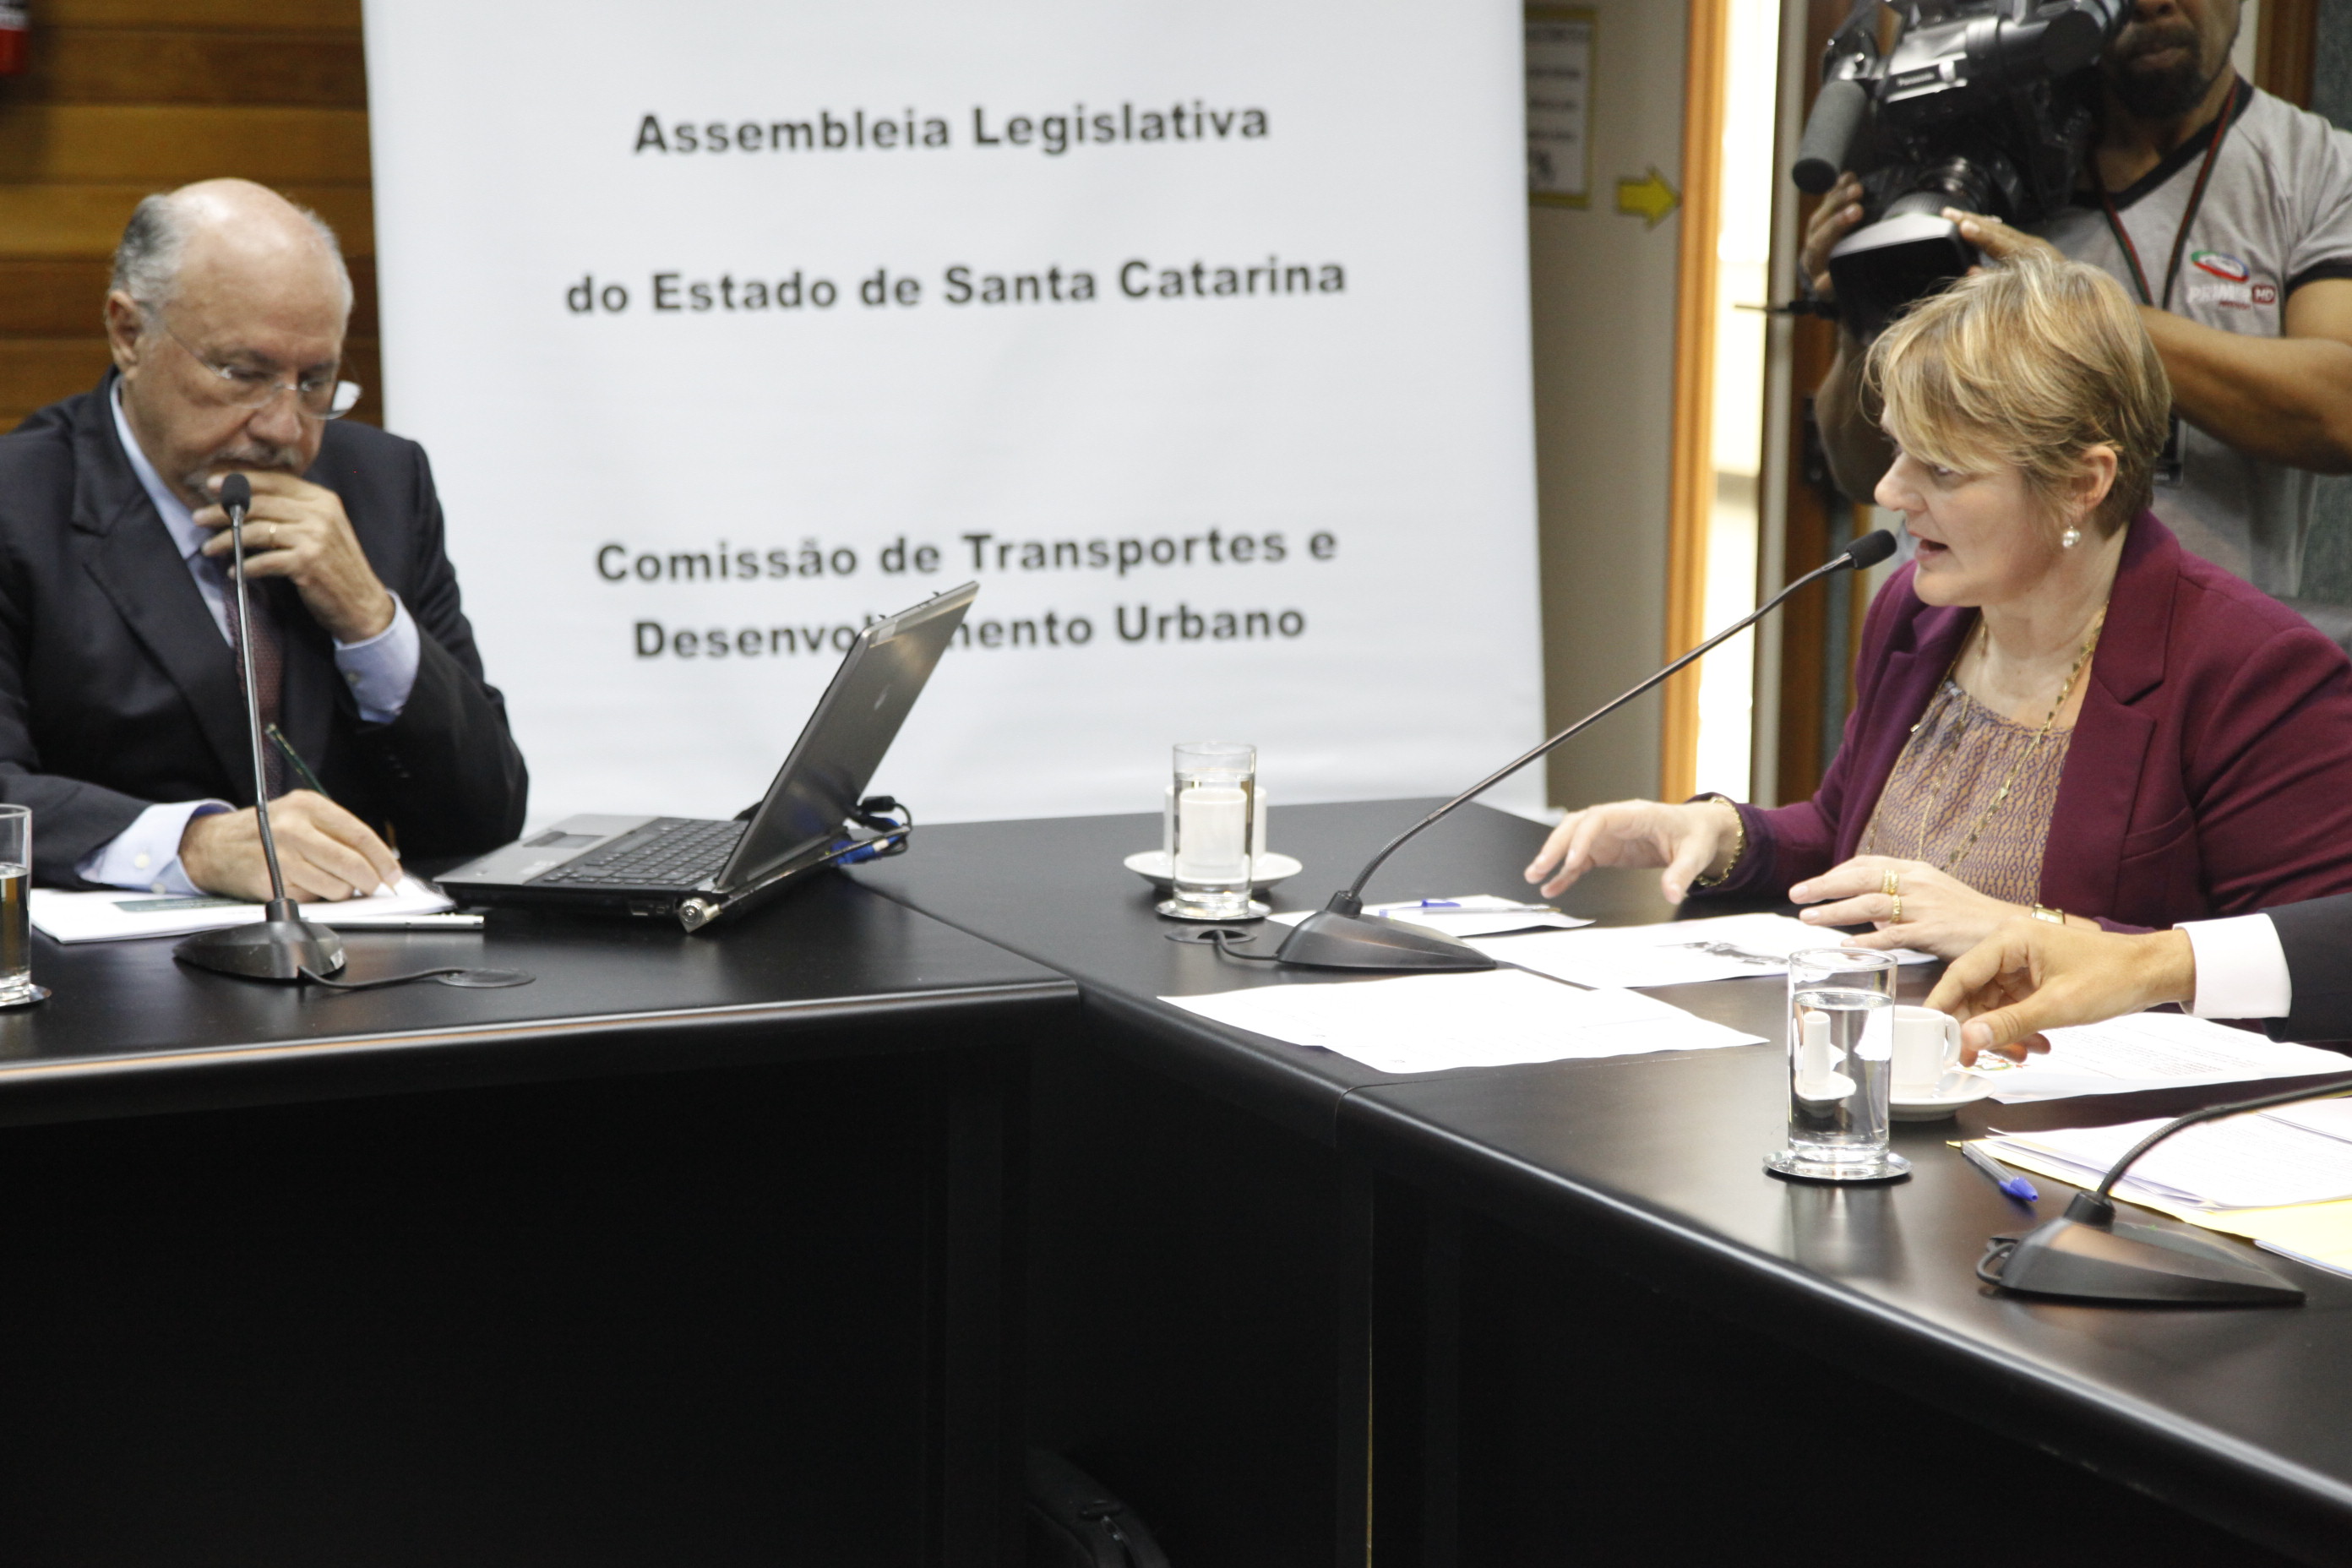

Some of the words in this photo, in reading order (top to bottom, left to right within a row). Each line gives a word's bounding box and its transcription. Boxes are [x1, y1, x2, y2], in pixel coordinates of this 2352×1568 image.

[634, 108, 950, 153] Assembleia
[973, 101, 1268, 156] Legislativa
[566, 275, 629, 313] do
[652, 270, 837, 312] Estado
[859, 268, 921, 307] de
[945, 265, 1097, 305] Santa
[1119, 256, 1345, 299] Catarina
[596, 537, 858, 582] Comissão
[879, 536, 940, 574] de
[961, 529, 1287, 578] Transportes
[1309, 531, 1337, 560] e
[1115, 603, 1305, 643] Urbano
